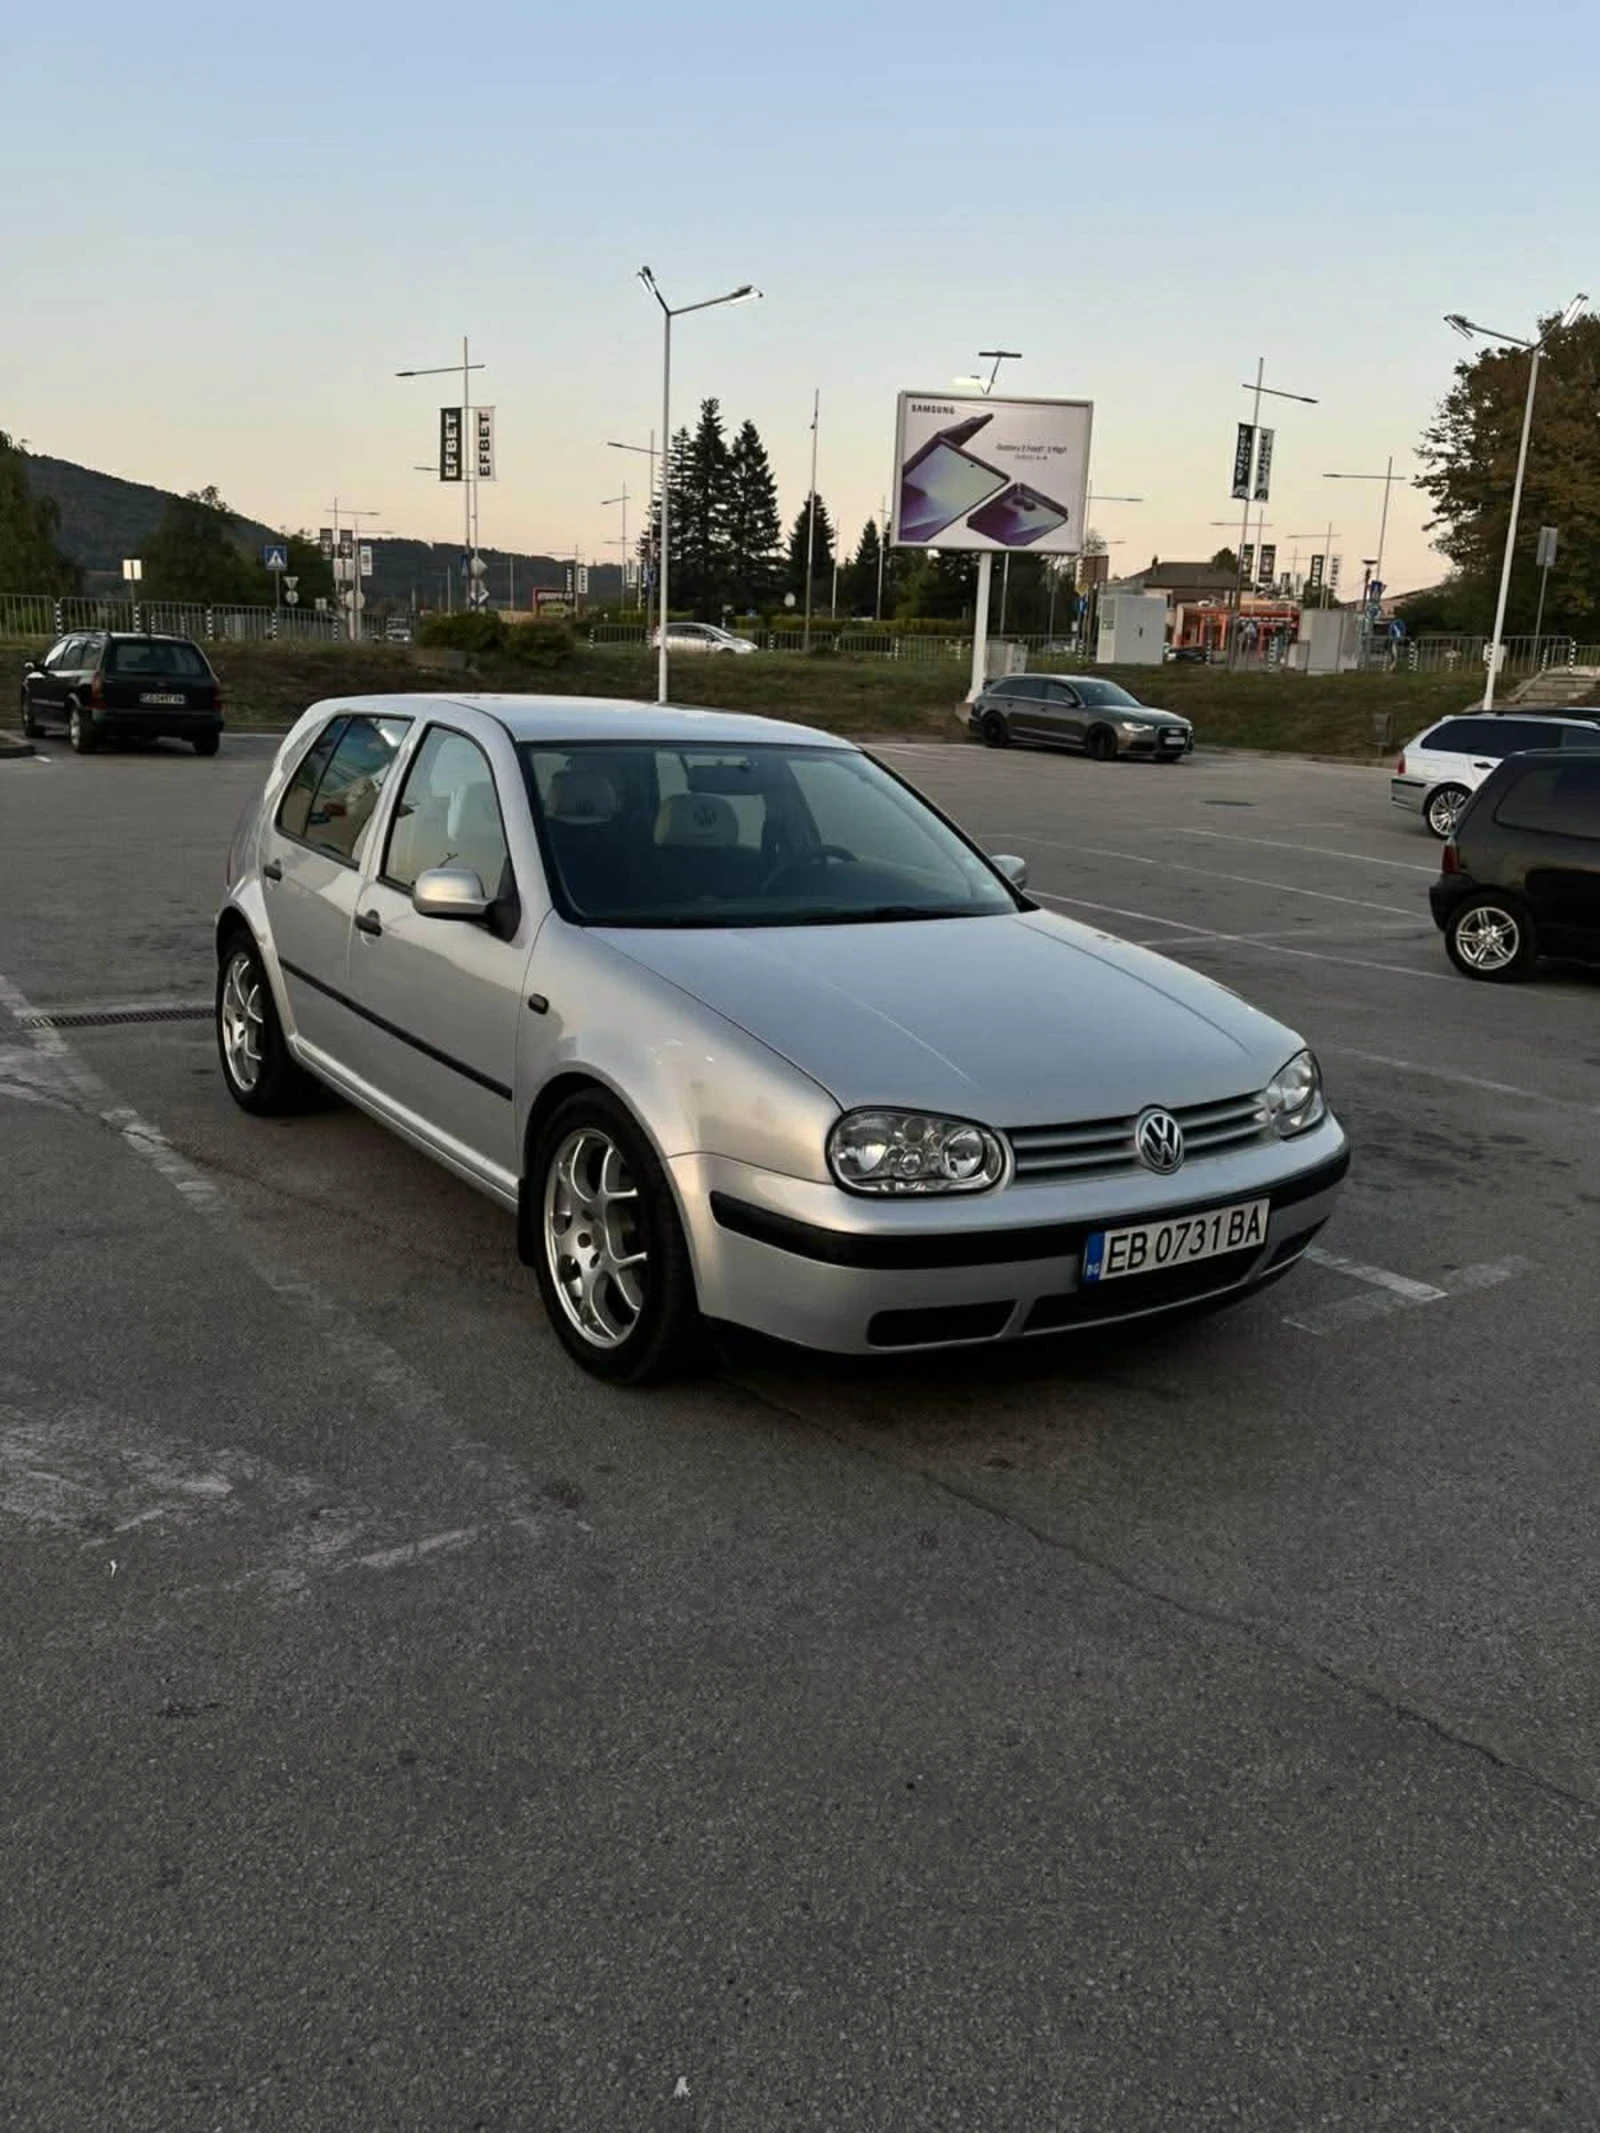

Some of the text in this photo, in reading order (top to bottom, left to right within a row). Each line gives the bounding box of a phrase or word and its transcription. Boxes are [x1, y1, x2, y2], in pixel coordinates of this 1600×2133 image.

[911, 404, 955, 415] SAMSUNG
[445, 412, 457, 477] EFBET
[479, 412, 491, 476] EFBET
[1106, 1205, 1260, 1274] EB 0731 BA
